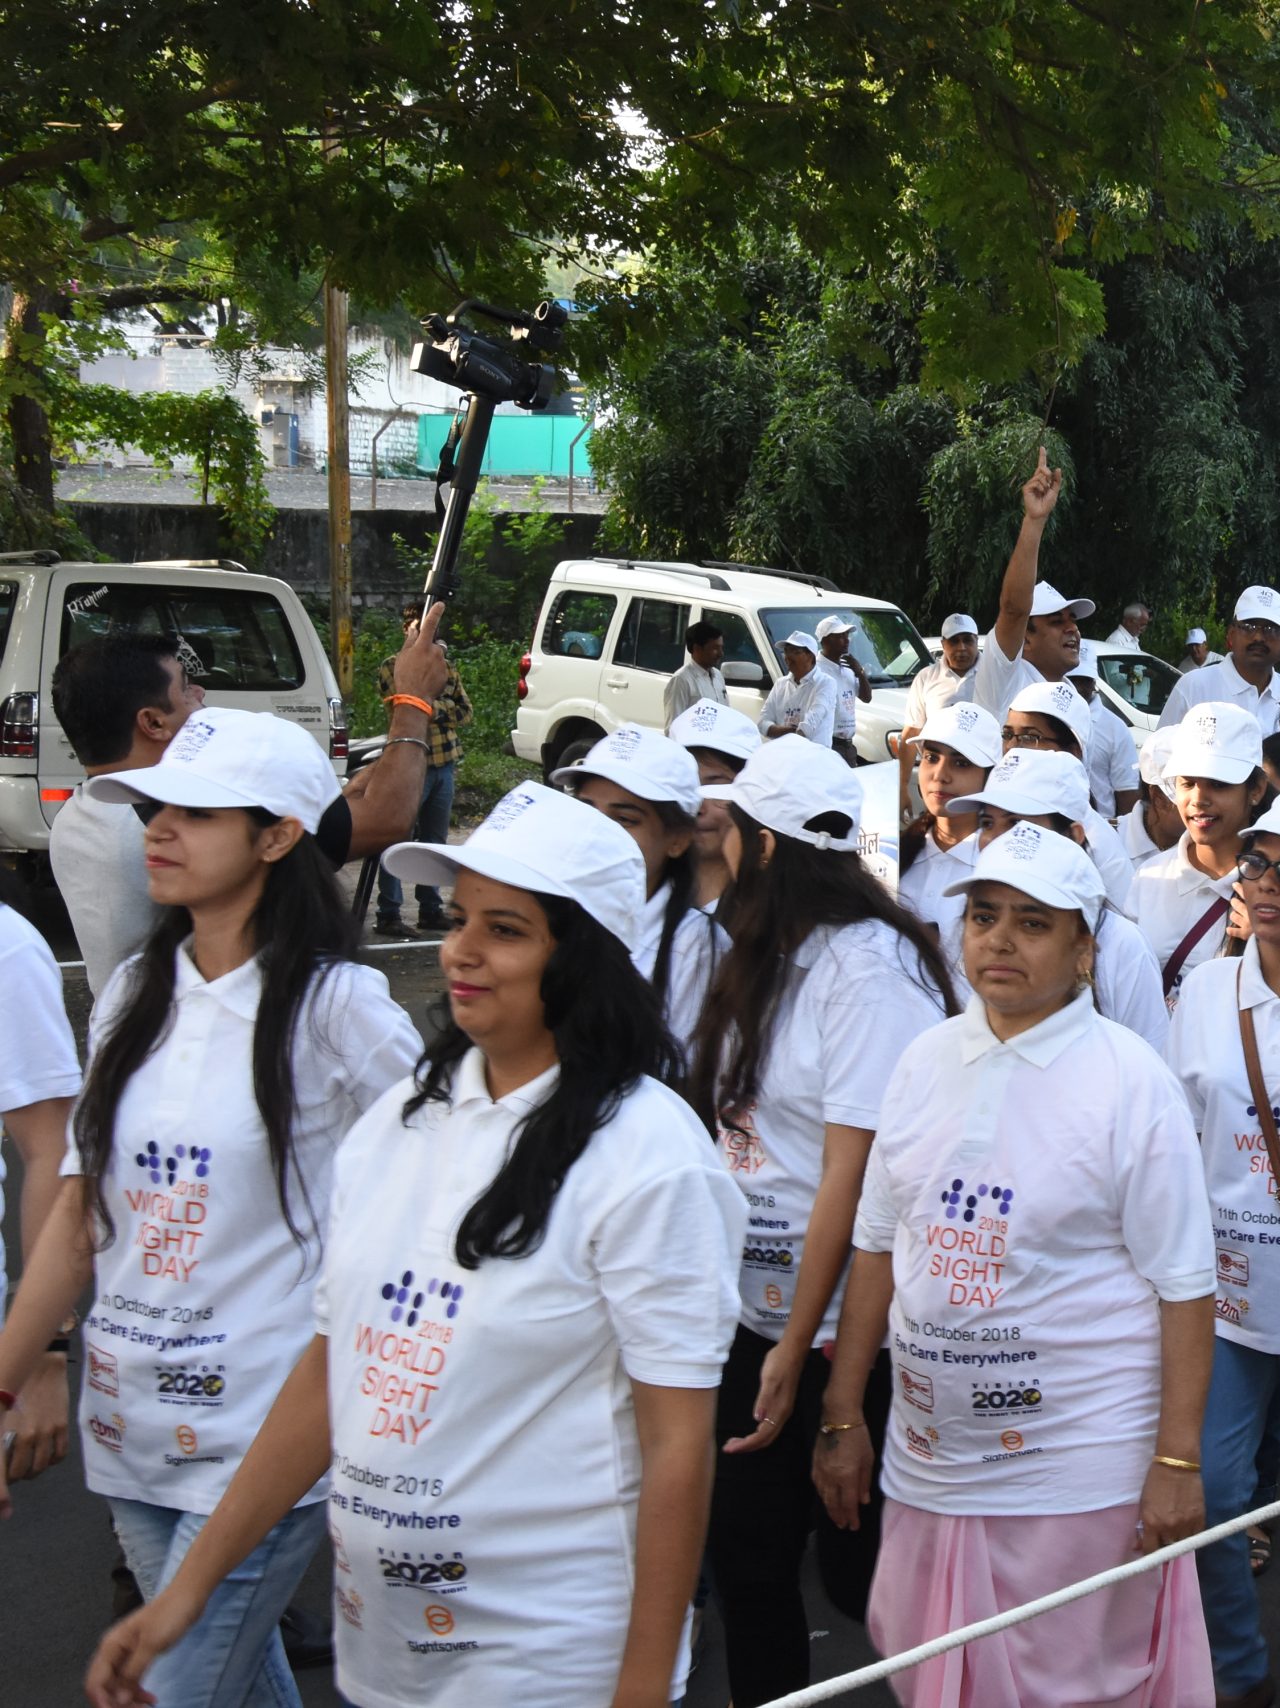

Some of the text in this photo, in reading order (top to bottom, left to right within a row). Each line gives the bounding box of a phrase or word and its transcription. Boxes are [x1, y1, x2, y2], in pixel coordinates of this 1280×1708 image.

[171, 1181, 208, 1197] 2018
[978, 1216, 1009, 1234] 2018
[1218, 1207, 1238, 1221] 11th
[926, 1224, 1006, 1259] WORLD
[1230, 1228, 1255, 1243] Care
[143, 1253, 199, 1283] DAY
[743, 1249, 794, 1266] 2020
[929, 1254, 1006, 1284] SIGHT
[949, 1283, 1005, 1308] DAY
[112, 1294, 213, 1324] October 2018
[1215, 1298, 1239, 1320] cbm
[101, 1317, 227, 1352] Care Everywhere
[418, 1320, 454, 1344] 2018
[922, 1322, 1021, 1341] October 2018
[354, 1322, 446, 1377] WORLD
[909, 1343, 938, 1361] Care
[942, 1350, 1037, 1368] Everywhere
[158, 1373, 225, 1397] 2020
[359, 1365, 439, 1413] SIGHT
[972, 1388, 1042, 1409] 2020
[369, 1406, 431, 1446] DAY
[341, 1454, 445, 1498] October 2018
[352, 1495, 462, 1529] Everywhere
[380, 1558, 467, 1585] 2020
[407, 1640, 480, 1655] Sightsavers
